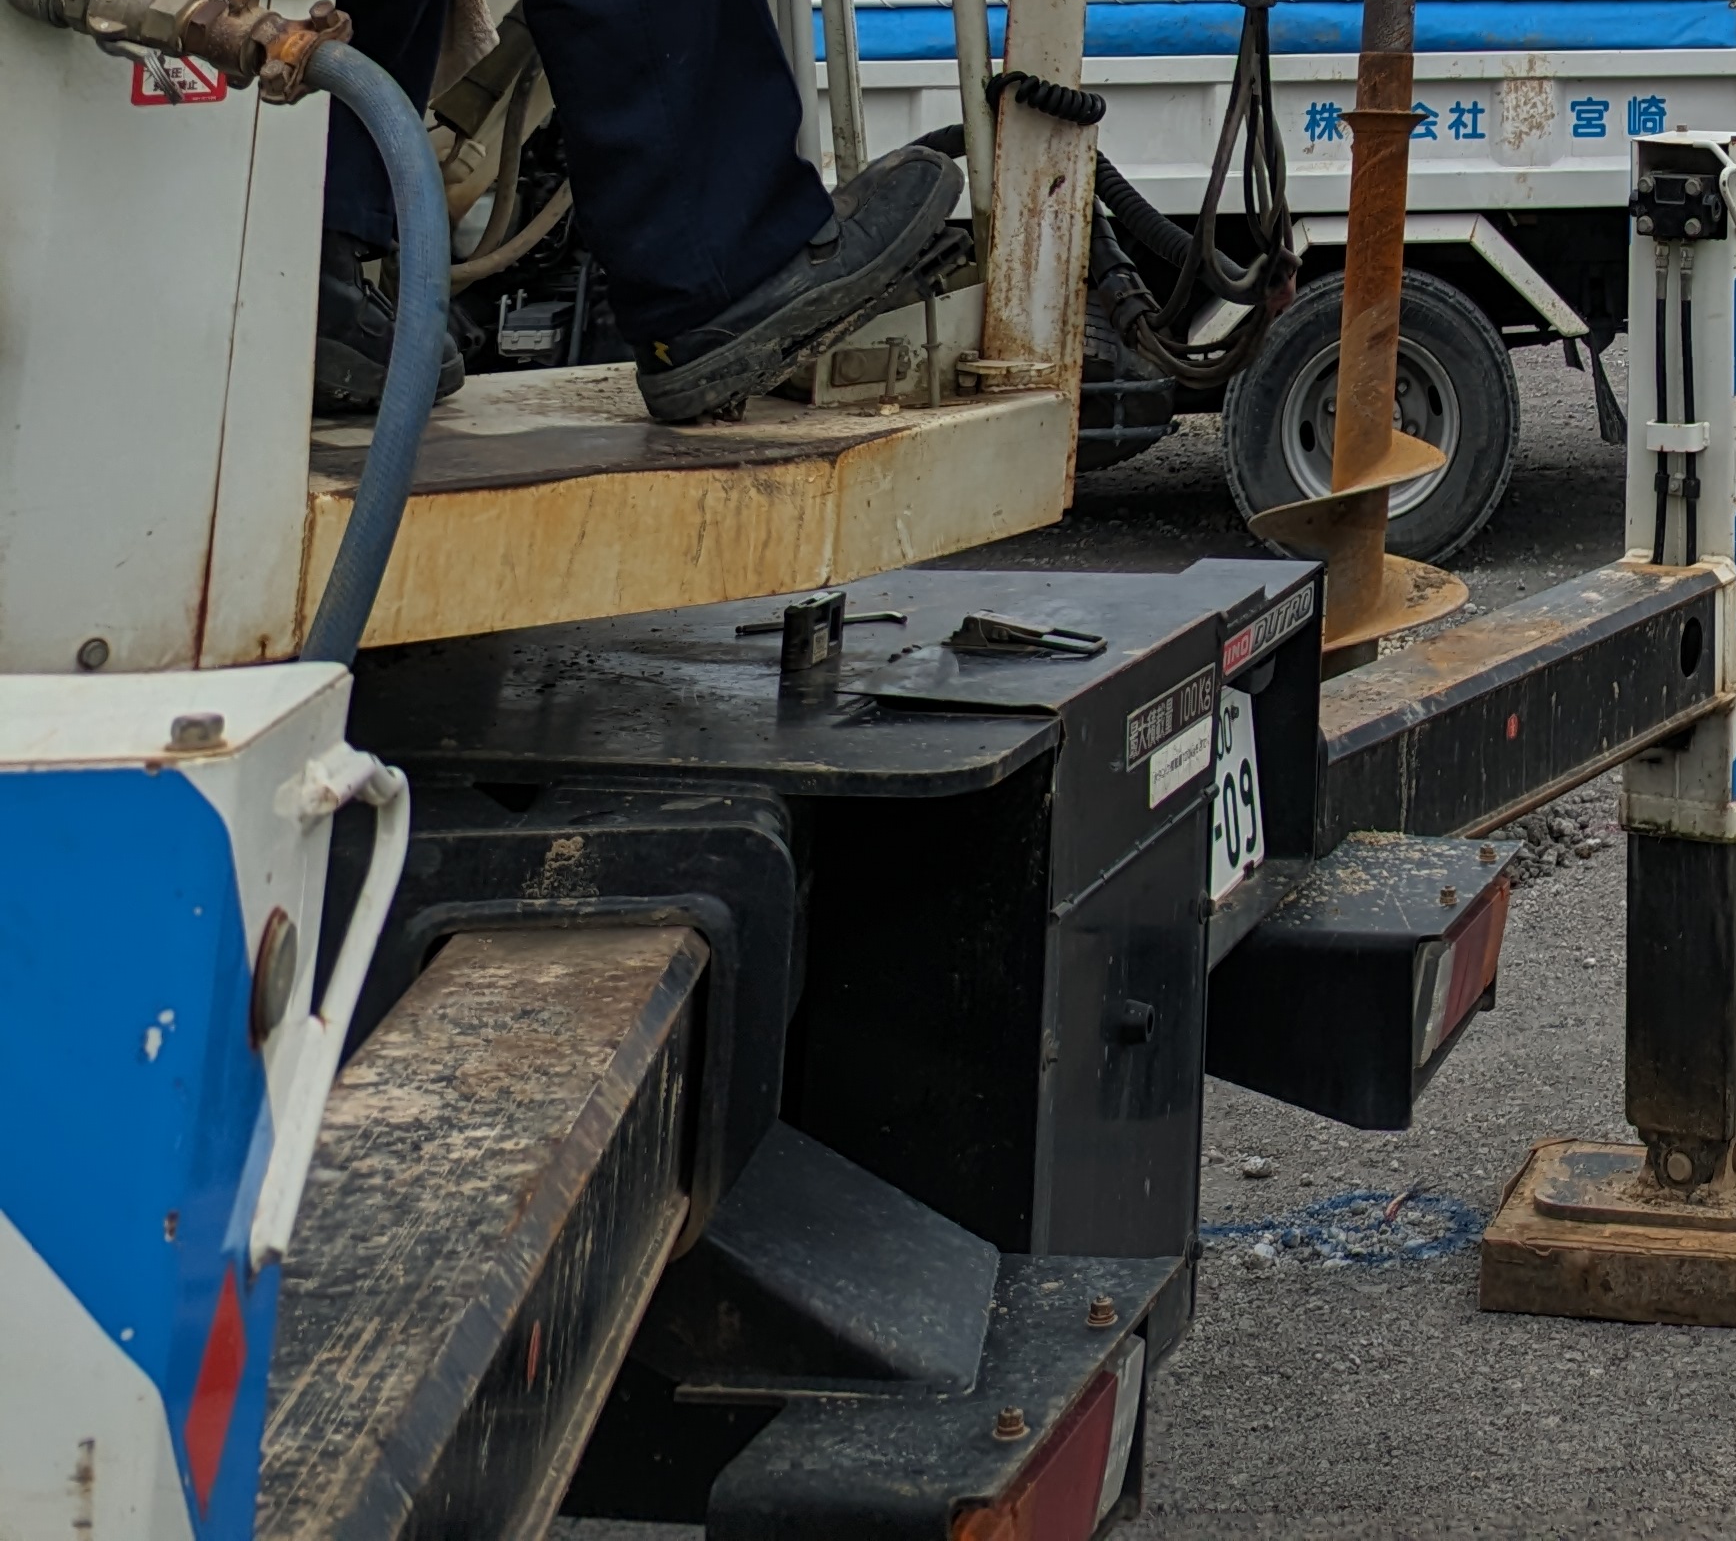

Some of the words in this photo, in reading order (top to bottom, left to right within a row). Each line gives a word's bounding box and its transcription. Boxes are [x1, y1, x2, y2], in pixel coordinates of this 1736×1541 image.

[1303, 100, 1488, 142] 株会社
[1569, 94, 1669, 139] 宮崎
[1252, 585, 1313, 647] DUTRO
[1128, 695, 1175, 761] 最大積載量
